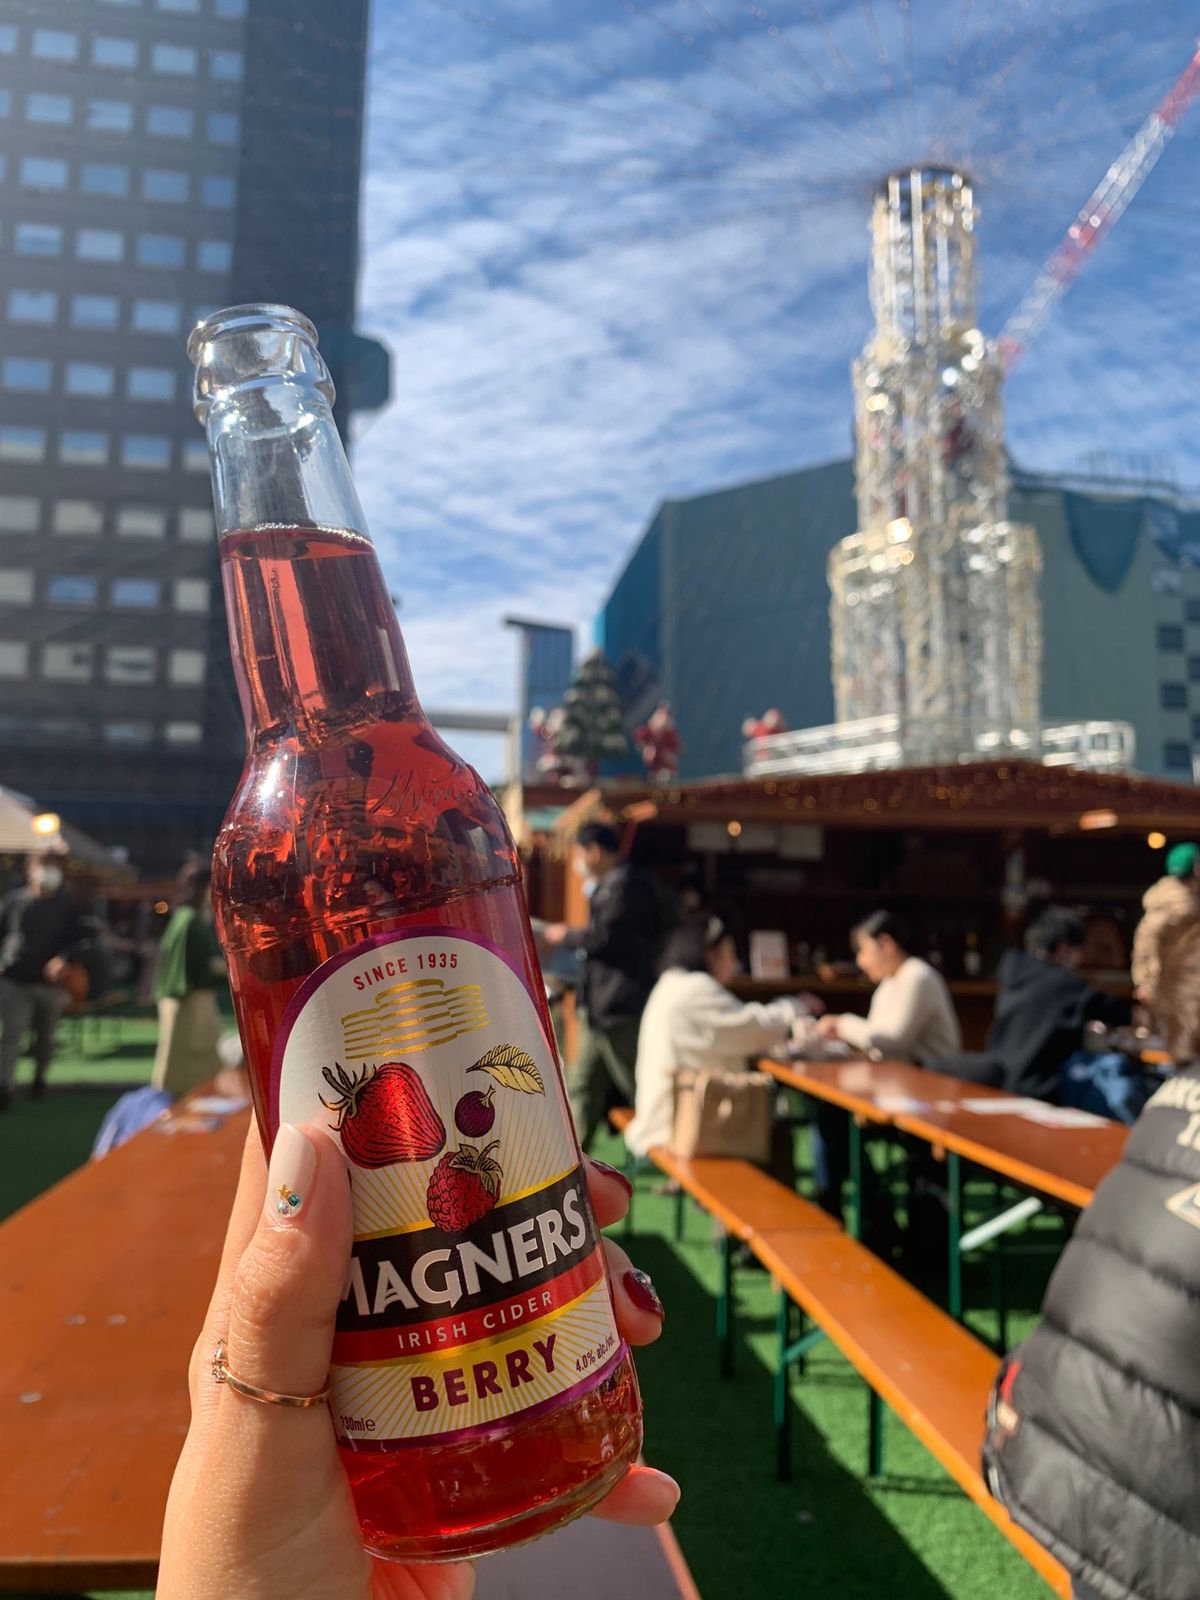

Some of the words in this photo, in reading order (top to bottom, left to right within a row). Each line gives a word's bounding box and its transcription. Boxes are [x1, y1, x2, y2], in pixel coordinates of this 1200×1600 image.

[353, 958, 408, 991] SINCE
[417, 953, 458, 970] 1935
[398, 1322, 467, 1349] IRISH
[483, 1291, 553, 1329] CIDER
[410, 1333, 557, 1413] BERRY
[575, 1349, 596, 1372] 4.0%
